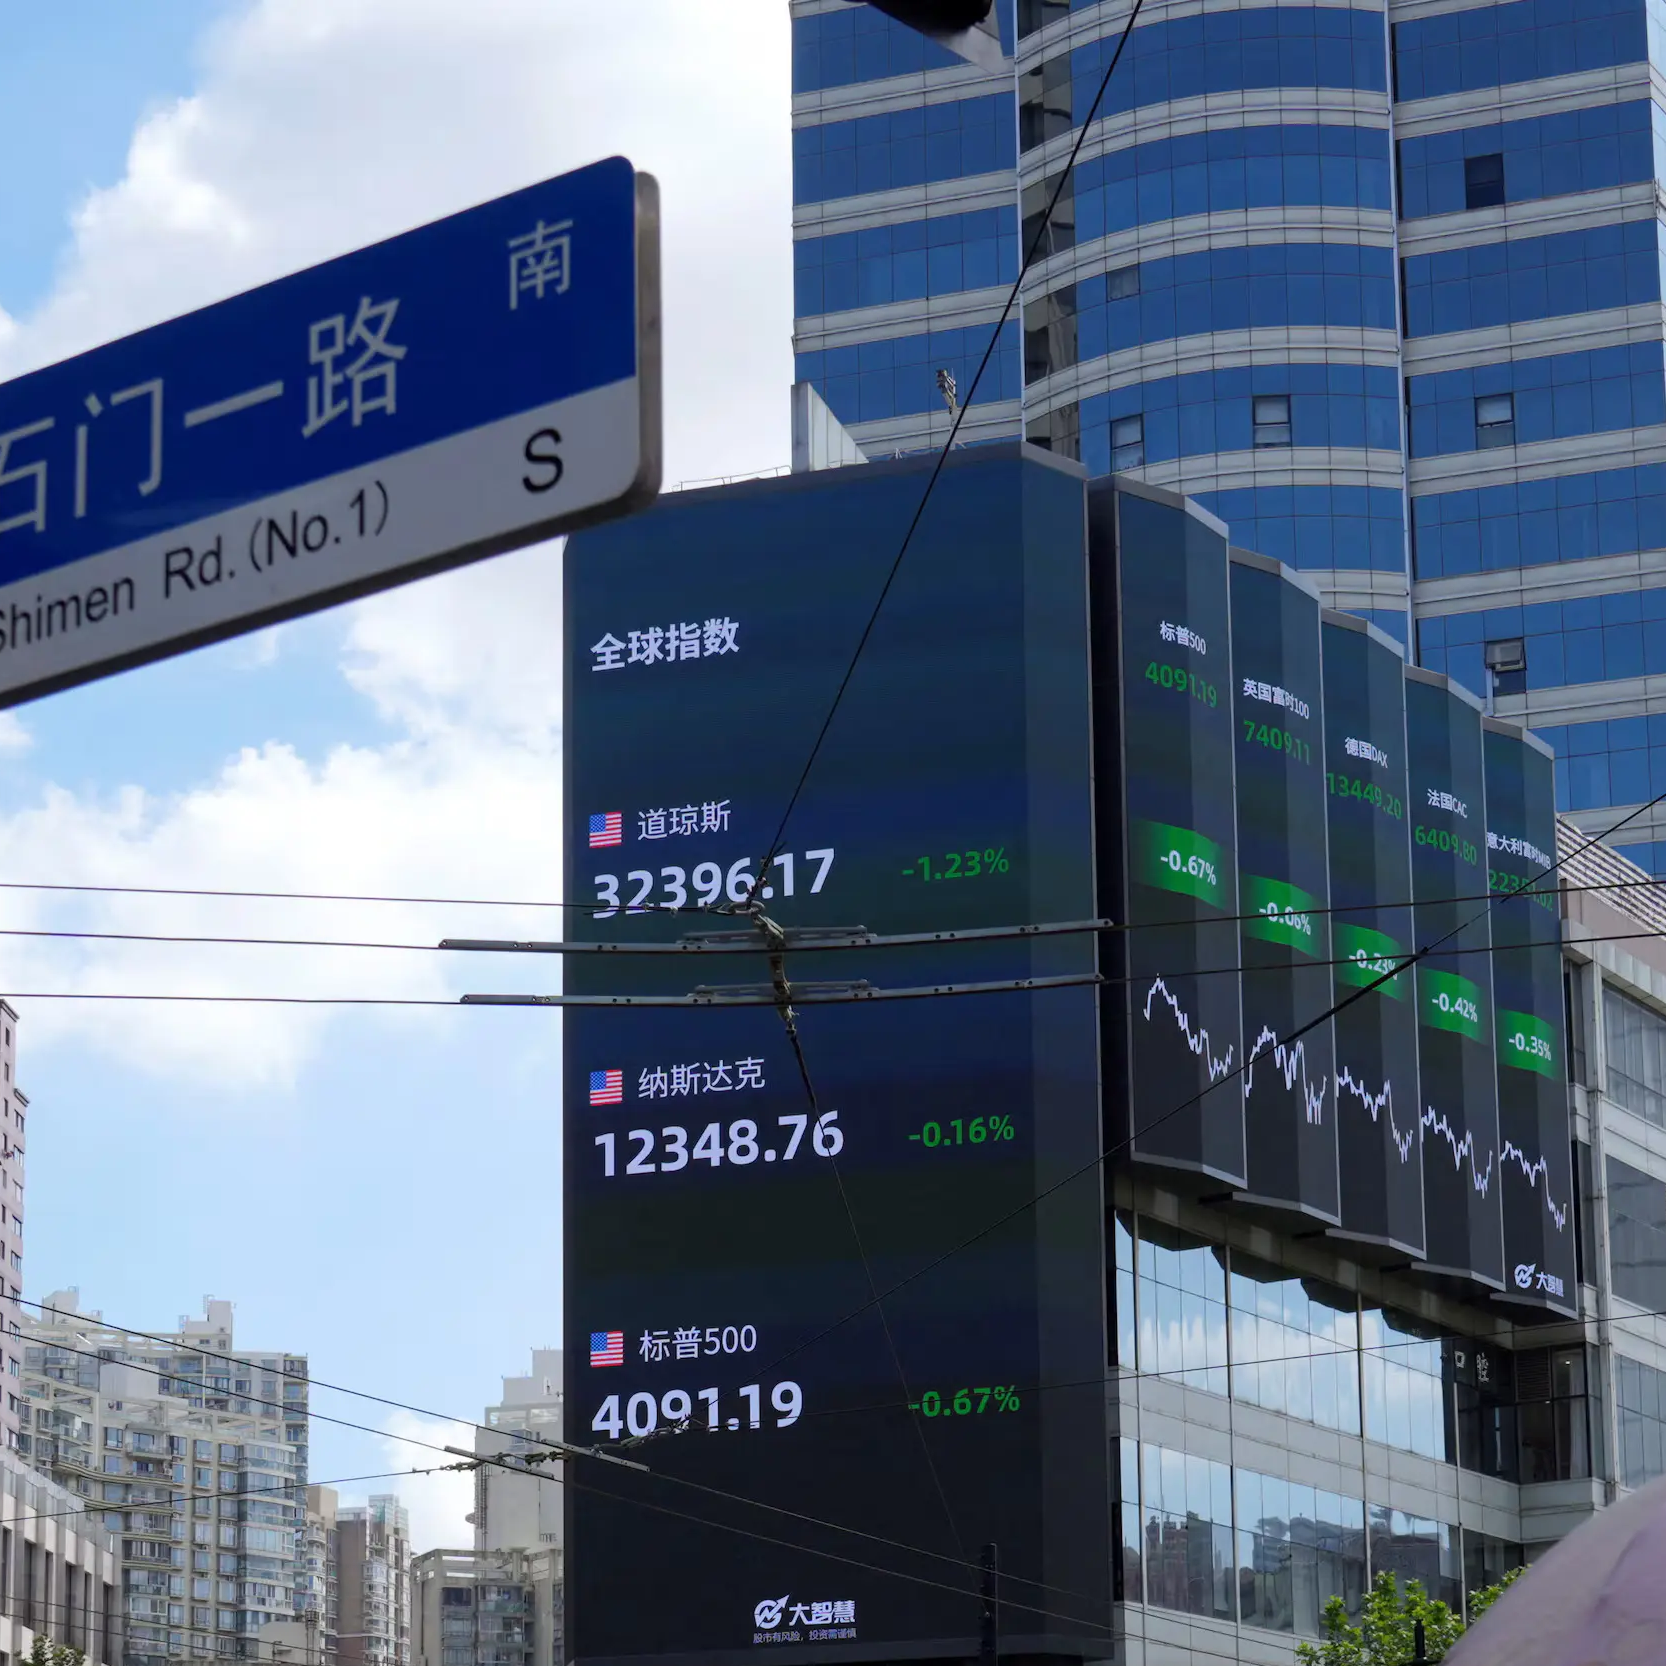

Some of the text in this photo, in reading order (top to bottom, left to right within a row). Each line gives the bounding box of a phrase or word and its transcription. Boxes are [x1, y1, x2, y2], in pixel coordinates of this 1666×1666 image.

[506, 218, 574, 310] 南
[522, 427, 564, 495] S
[164, 534, 235, 601] Rd.
[249, 480, 390, 575] (No.1)
[589, 616, 740, 672] 全球指数
[1159, 620, 1207, 656] 标普500
[1144, 661, 1218, 709] 4091.19
[1242, 678, 1310, 721] 英国富时100
[1243, 719, 1311, 766] 7409.11
[1344, 736, 1388, 770] 德国DAX
[1327, 771, 1403, 821] 13449.20
[1427, 788, 1468, 819] 法国CAC
[637, 799, 731, 842] 道琼斯
[901, 846, 1010, 883] -1.23%
[1414, 824, 1478, 867] 6409.80
[592, 847, 836, 920] 32396.17
[1160, 850, 1217, 886] -0.67%
[1259, 901, 1312, 937] -0.06%
[1431, 992, 1479, 1024] -0.42%
[1507, 1032, 1553, 1062] -0.35%
[638, 1056, 766, 1101] 纳斯达克
[594, 1110, 845, 1178] 12348.76
[907, 1115, 1015, 1149] -0.16%
[639, 1324, 757, 1364] 标普500
[590, 1380, 804, 1440] 4091.19
[908, 1384, 1021, 1419] -0.67%
[789, 1600, 856, 1627] 大智慧
